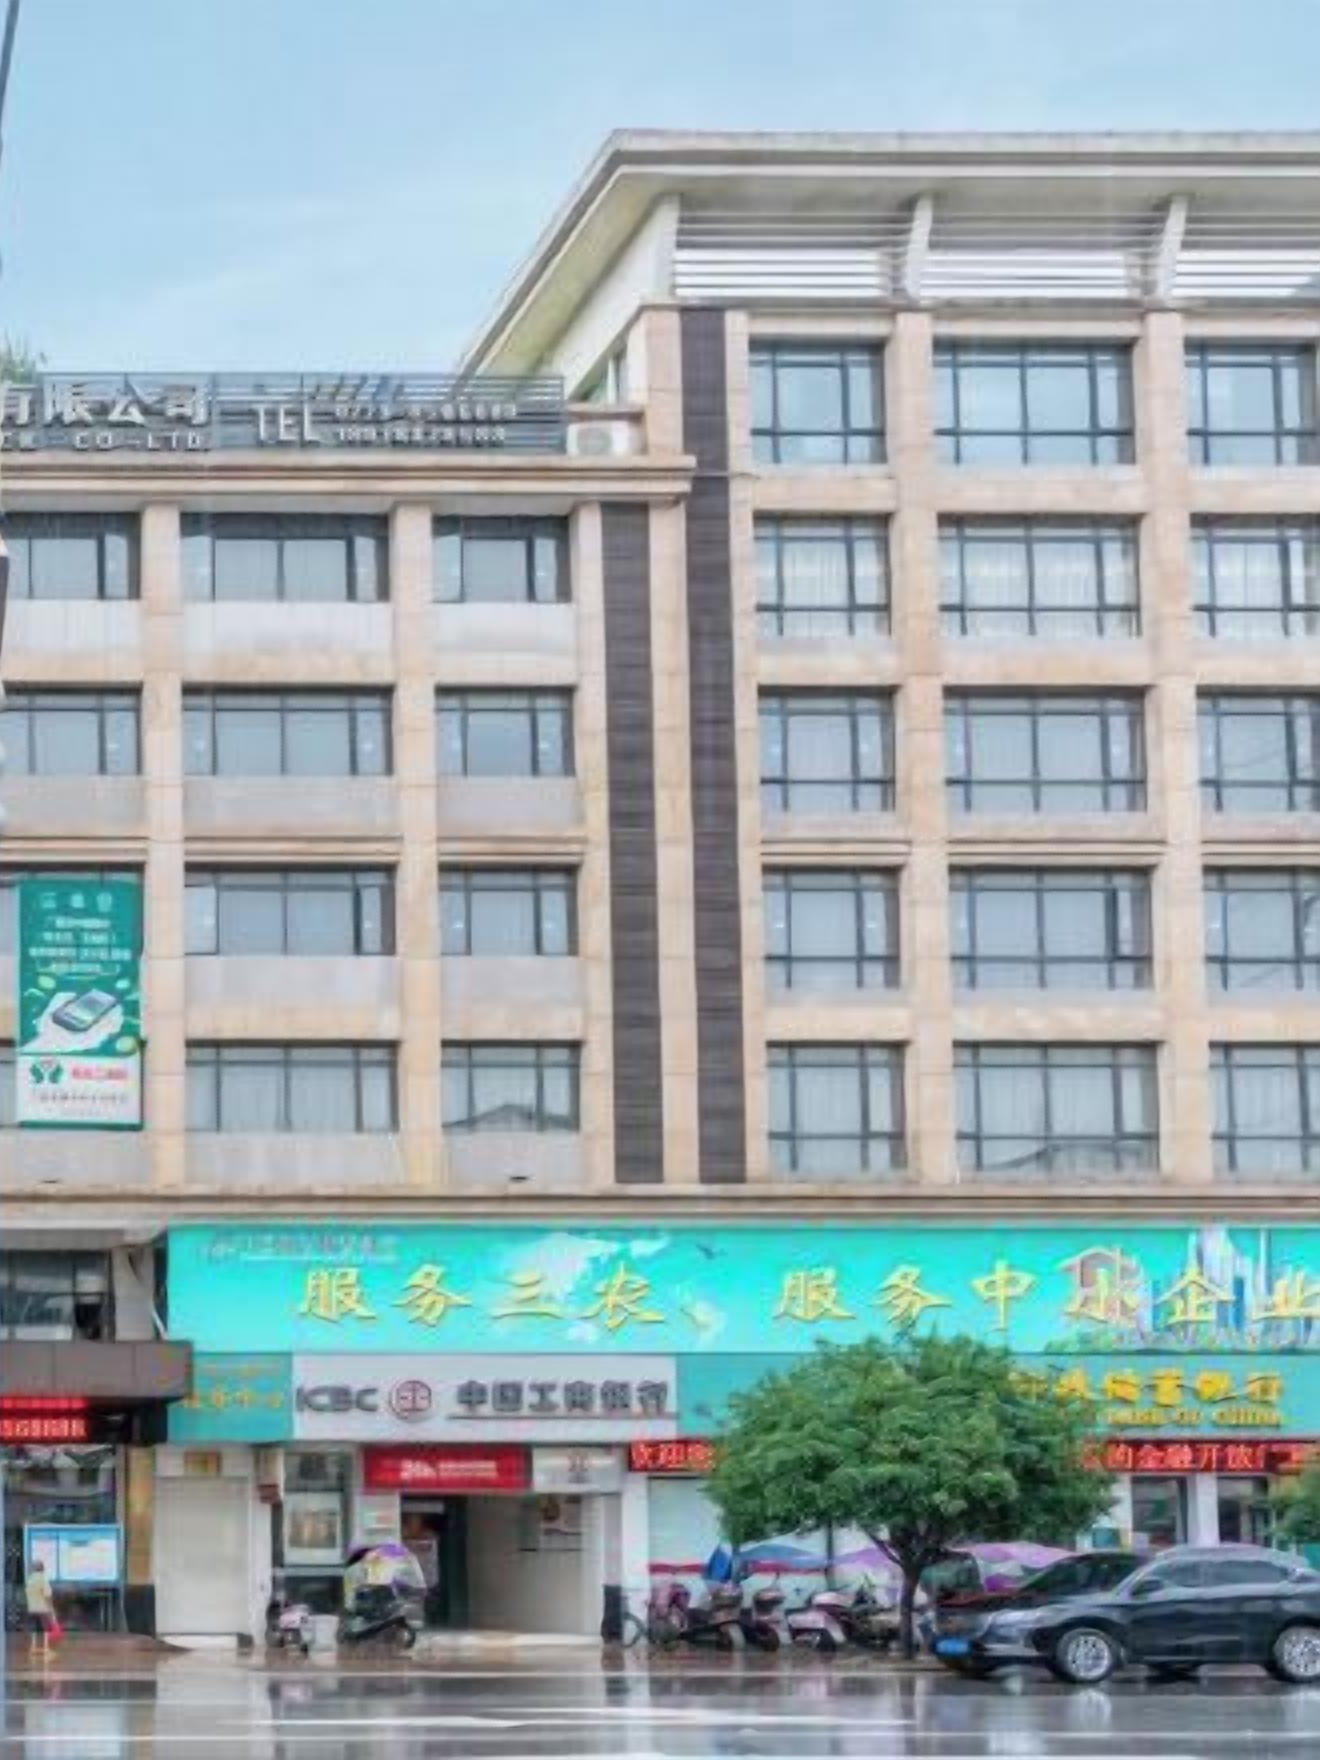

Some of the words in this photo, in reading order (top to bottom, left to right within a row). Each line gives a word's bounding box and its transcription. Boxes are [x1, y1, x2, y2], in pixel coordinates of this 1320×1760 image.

[253, 402, 322, 441] TEL
[456, 1380, 669, 1413] 中国工商银行
